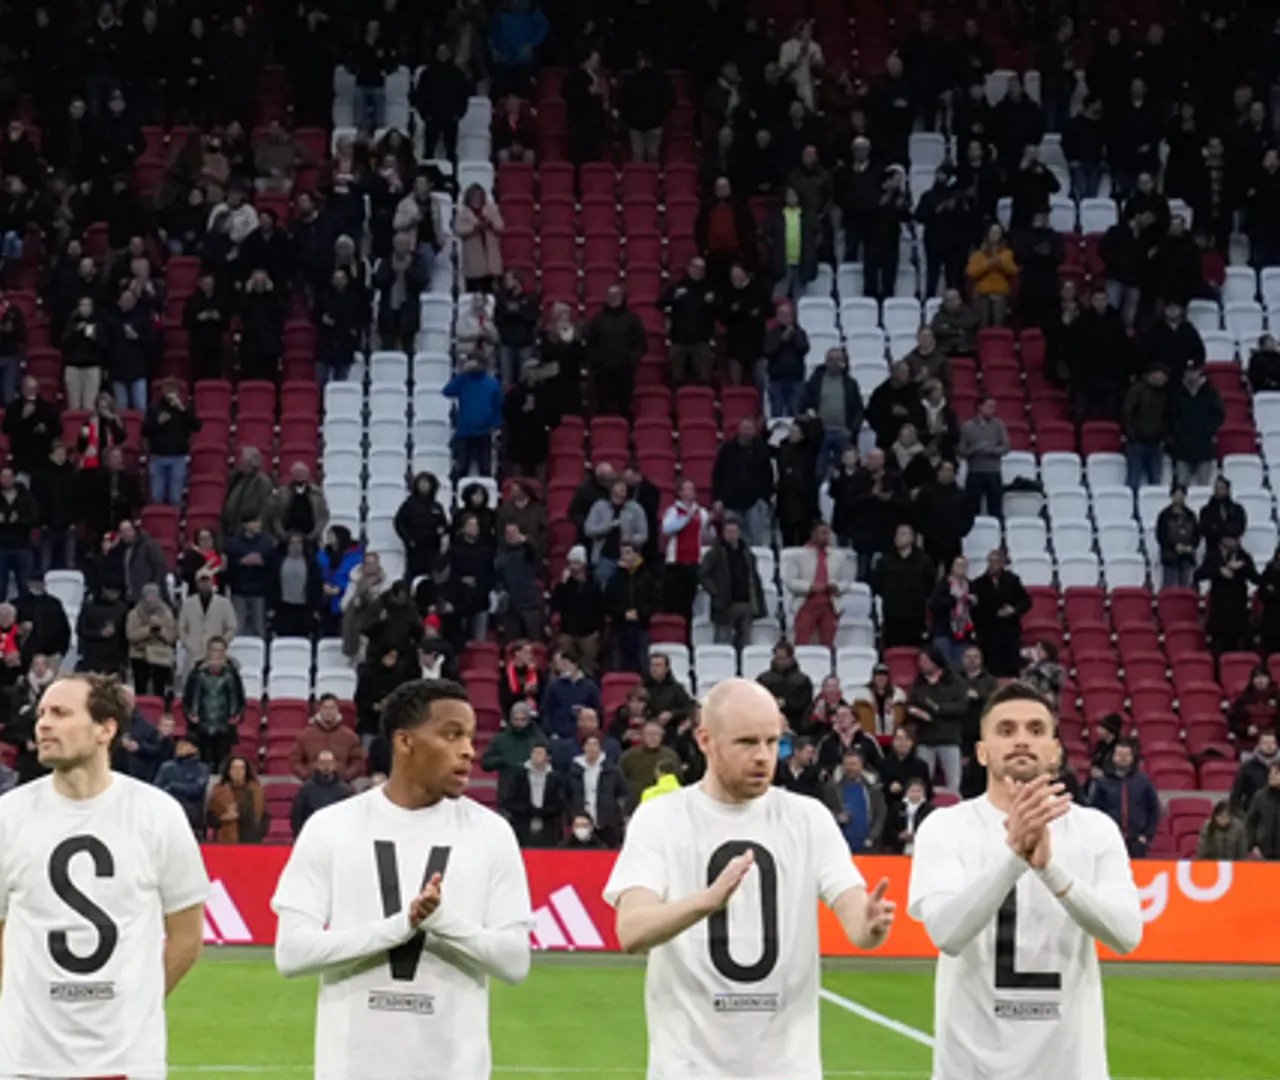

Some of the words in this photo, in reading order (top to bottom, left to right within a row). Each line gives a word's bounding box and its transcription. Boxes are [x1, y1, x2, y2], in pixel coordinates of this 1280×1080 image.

[47, 834, 118, 974] S
[374, 840, 451, 981] V
[994, 884, 1061, 990] L
